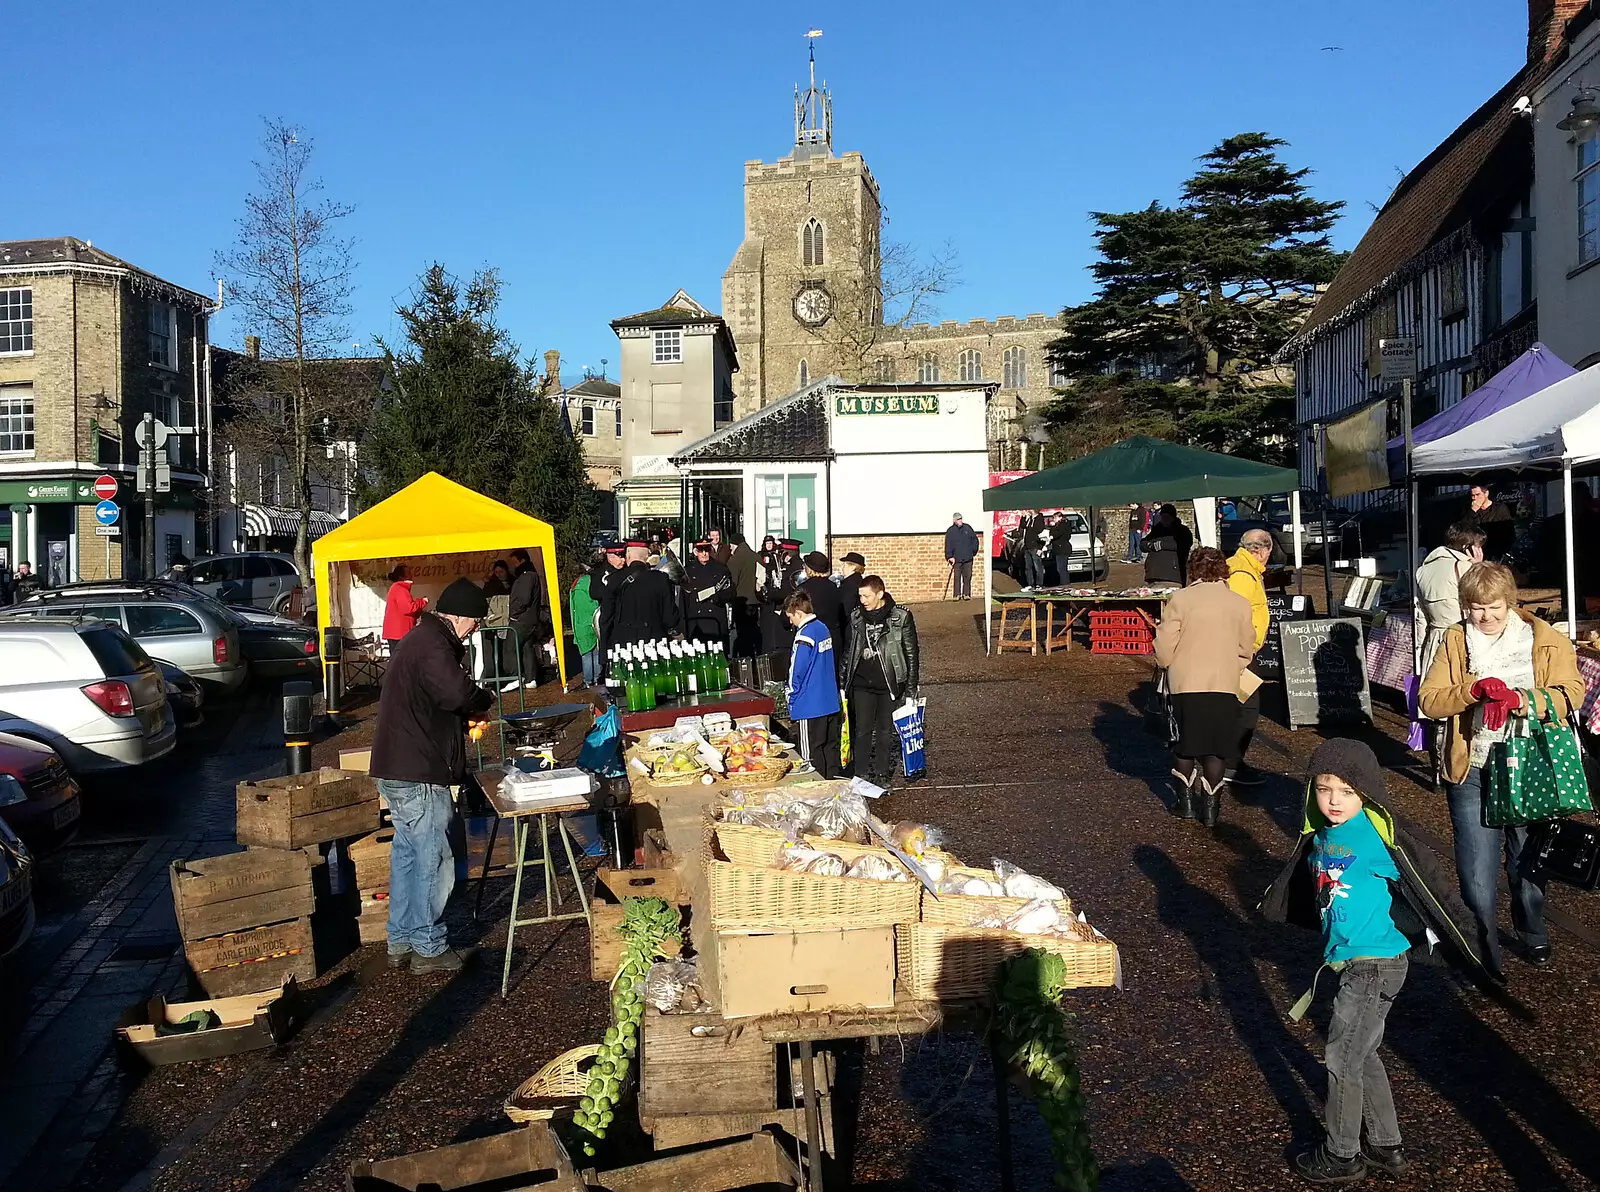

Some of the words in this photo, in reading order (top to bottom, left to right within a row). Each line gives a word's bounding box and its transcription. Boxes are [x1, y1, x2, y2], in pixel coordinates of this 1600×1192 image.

[1381, 349, 1414, 357] Cottage
[1382, 341, 1405, 350] Spice
[840, 396, 937, 413] MUSEUM
[452, 555, 497, 581] Fudg
[1268, 608, 1294, 620] sages
[1285, 623, 1311, 635] Award
[1312, 621, 1351, 638] Winning
[1298, 634, 1343, 652] PORK
[905, 738, 924, 755] Like
[225, 870, 277, 890] MARRIOTT
[232, 929, 274, 946] MARRIOTT
[216, 944, 261, 963] CARLETON
